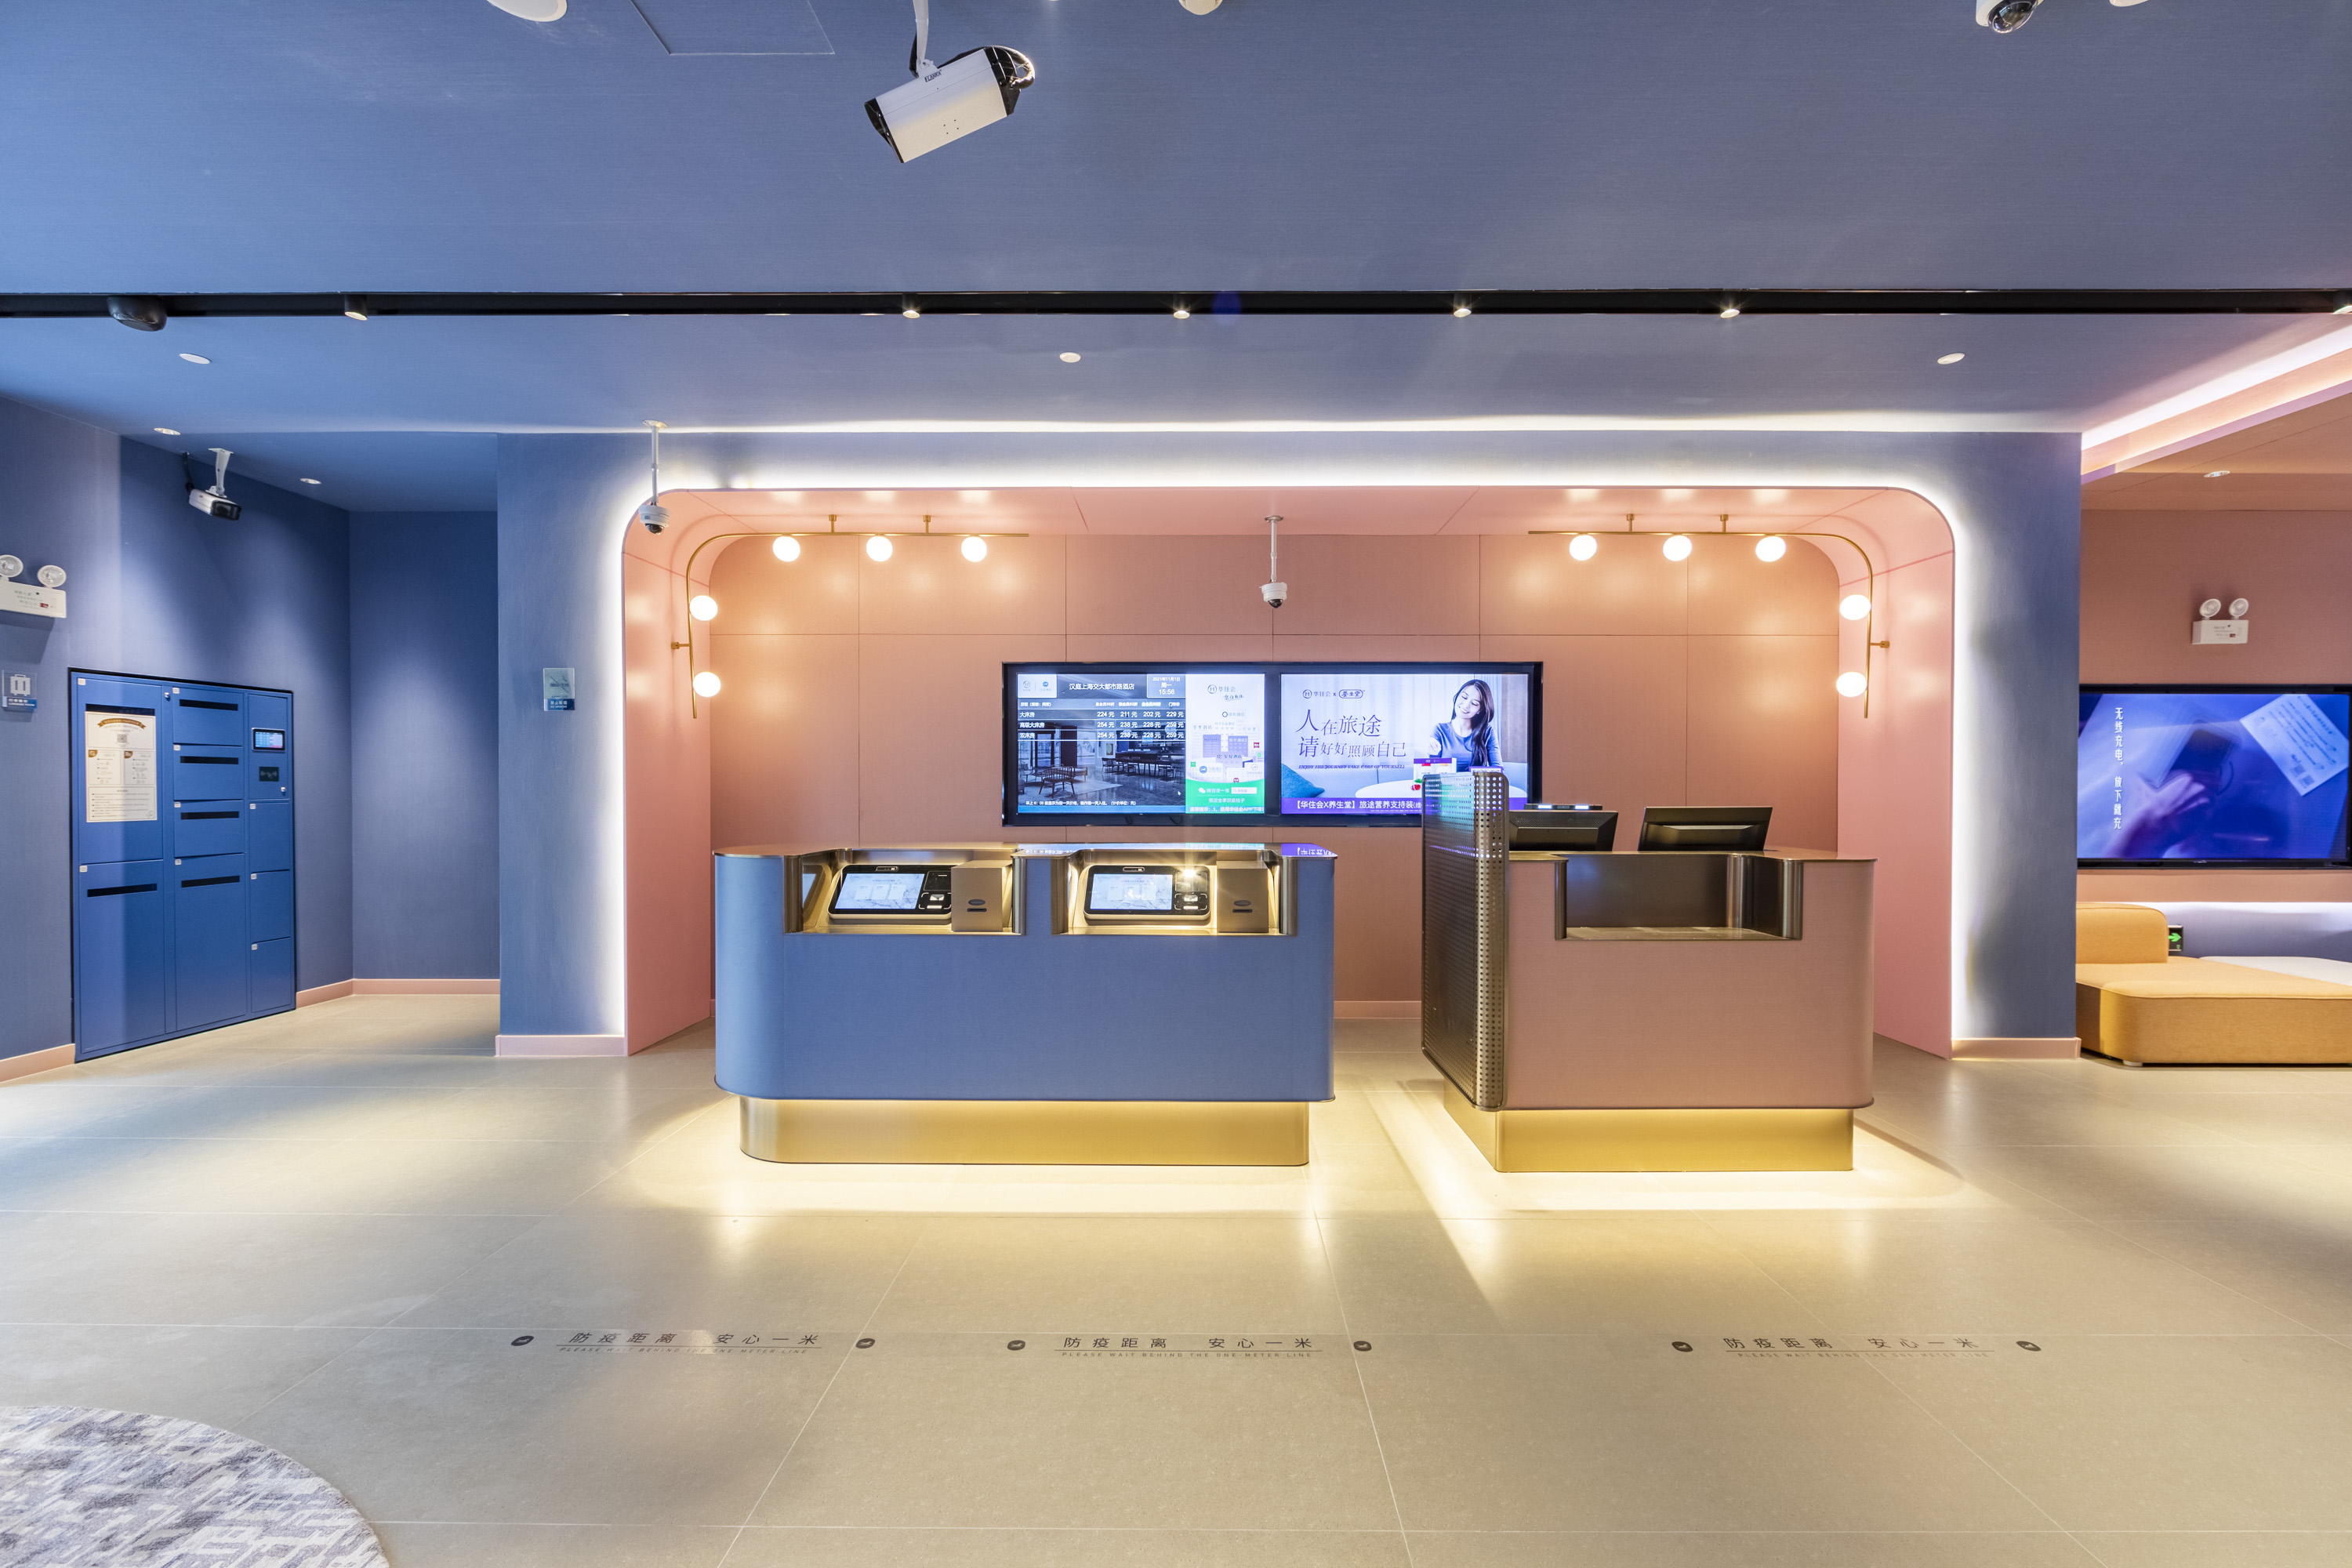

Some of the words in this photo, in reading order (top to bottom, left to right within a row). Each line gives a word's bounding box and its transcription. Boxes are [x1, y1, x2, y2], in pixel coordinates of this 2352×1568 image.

[1295, 709, 1382, 737] 人在旅途
[1298, 736, 1406, 758] 请好好照顾自己
[568, 1332, 677, 1343] 防疫距离
[713, 1334, 818, 1345] 安心一米
[1064, 1338, 1167, 1348] 防疫距离
[1209, 1338, 1312, 1348] 安心一米
[1723, 1338, 1833, 1348] 防疫距离
[1867, 1338, 1979, 1348] 安心一米
